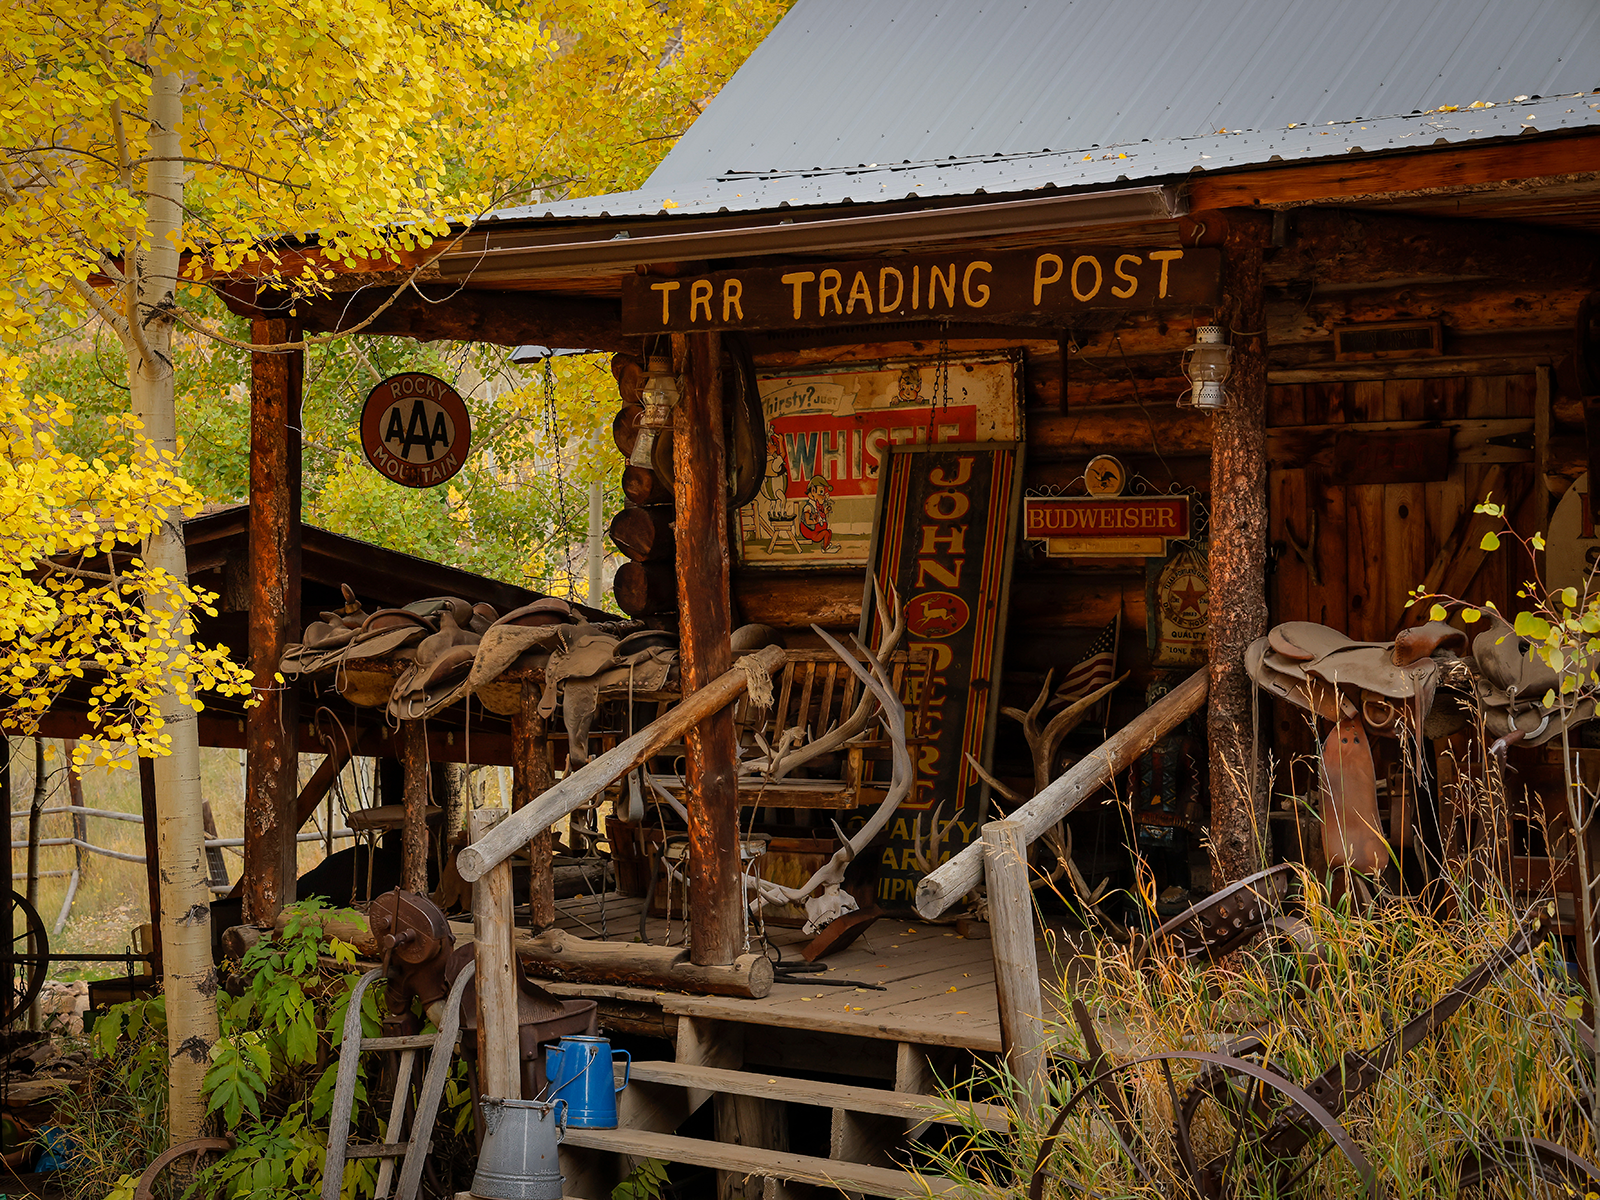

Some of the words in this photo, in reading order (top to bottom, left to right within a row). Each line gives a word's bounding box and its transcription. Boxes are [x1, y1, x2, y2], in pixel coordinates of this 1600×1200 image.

[650, 278, 744, 325] TRR
[781, 261, 993, 320] TRADING
[1033, 250, 1184, 306] POST
[390, 377, 448, 401] ROCKY
[814, 395, 839, 405] JUST
[385, 400, 449, 461] AAA
[373, 445, 458, 483] MOUTAIN
[1356, 443, 1424, 469] OPEN
[915, 456, 975, 588] JOHN
[1028, 507, 1177, 529] BUDWEISER
[1171, 630, 1206, 640] QUALITY
